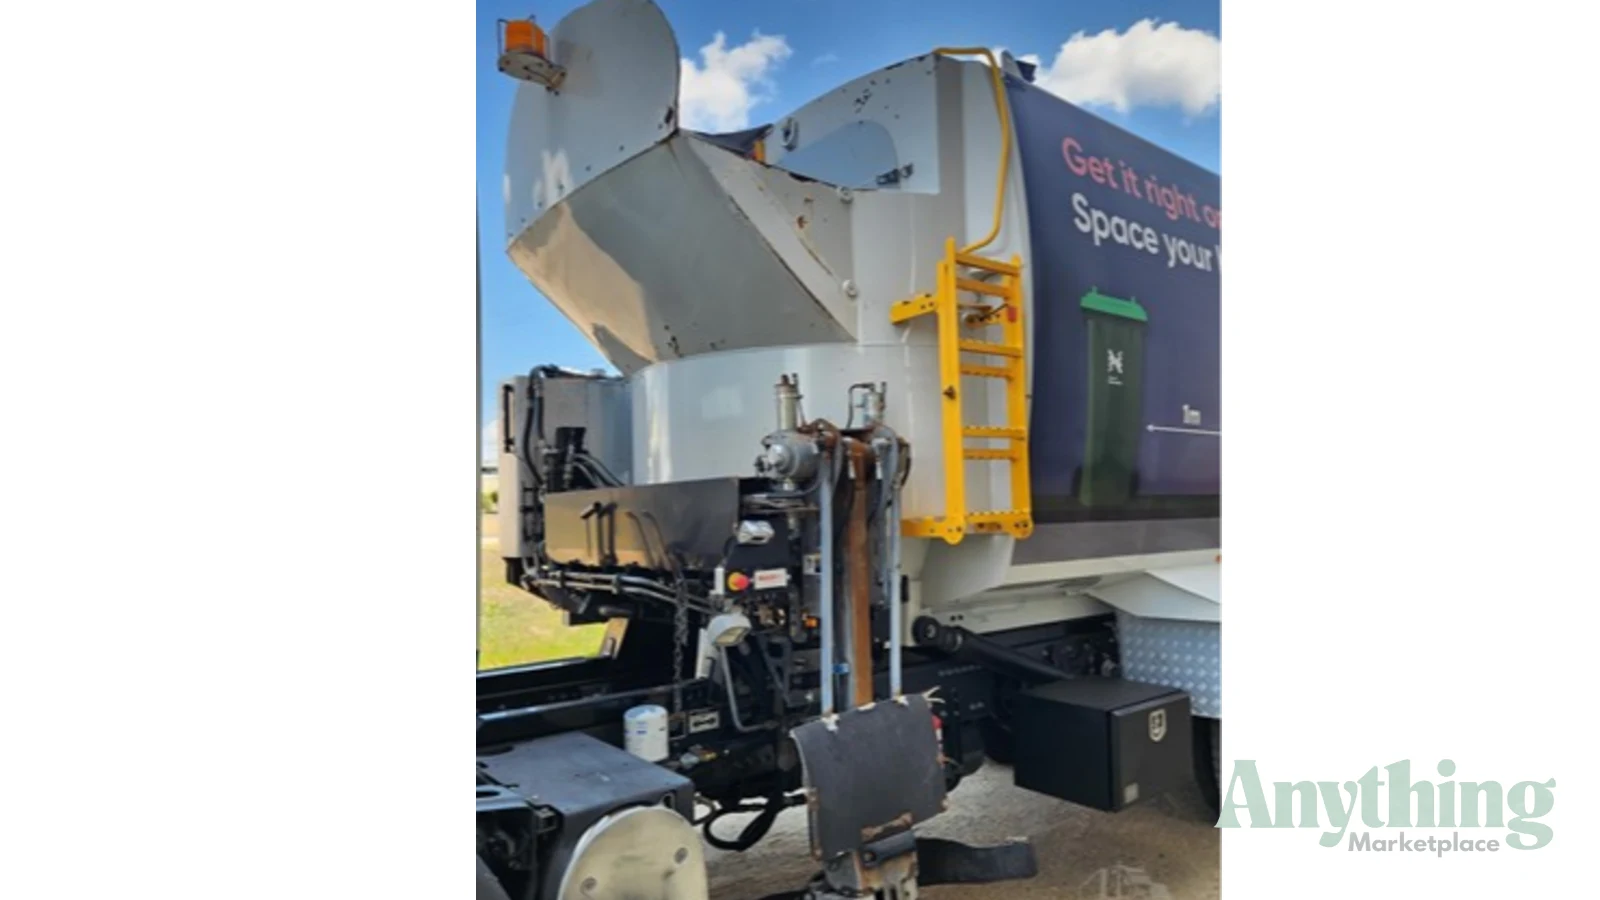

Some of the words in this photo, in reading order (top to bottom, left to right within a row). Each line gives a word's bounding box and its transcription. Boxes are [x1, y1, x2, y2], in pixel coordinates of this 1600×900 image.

[1062, 137, 1118, 188] Get
[1119, 160, 1142, 198] it
[1145, 175, 1201, 220] right
[1072, 192, 1159, 254] Space
[1163, 233, 1212, 272] your
